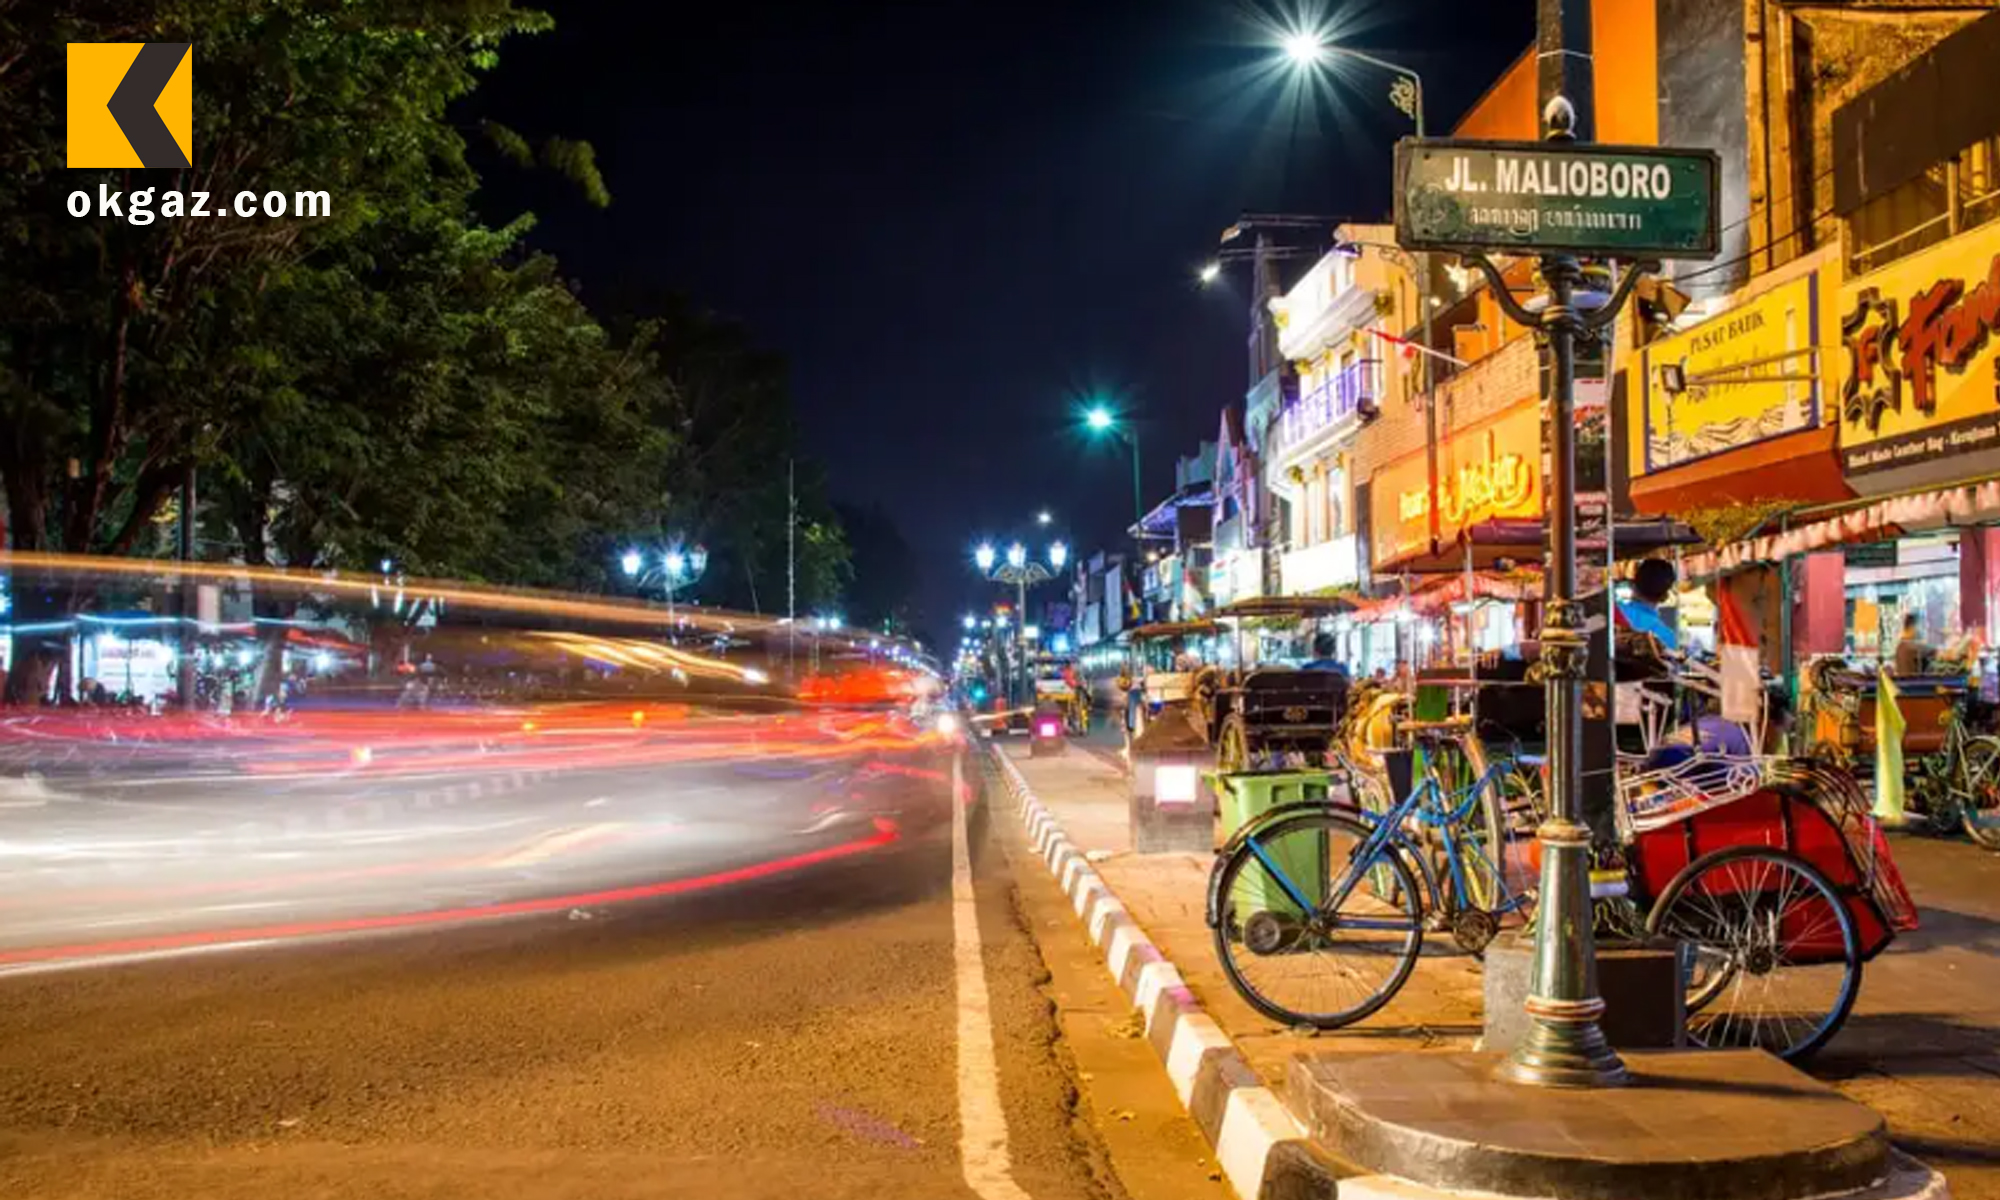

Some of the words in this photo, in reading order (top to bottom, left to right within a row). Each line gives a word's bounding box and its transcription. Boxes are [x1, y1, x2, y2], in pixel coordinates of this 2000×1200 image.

[1444, 156, 1487, 193] JL.
[1495, 158, 1671, 200] MALIOBORO
[1689, 324, 1727, 356] PUSAT
[1728, 309, 1766, 339] BATIK
[1926, 436, 1944, 452] Bag
